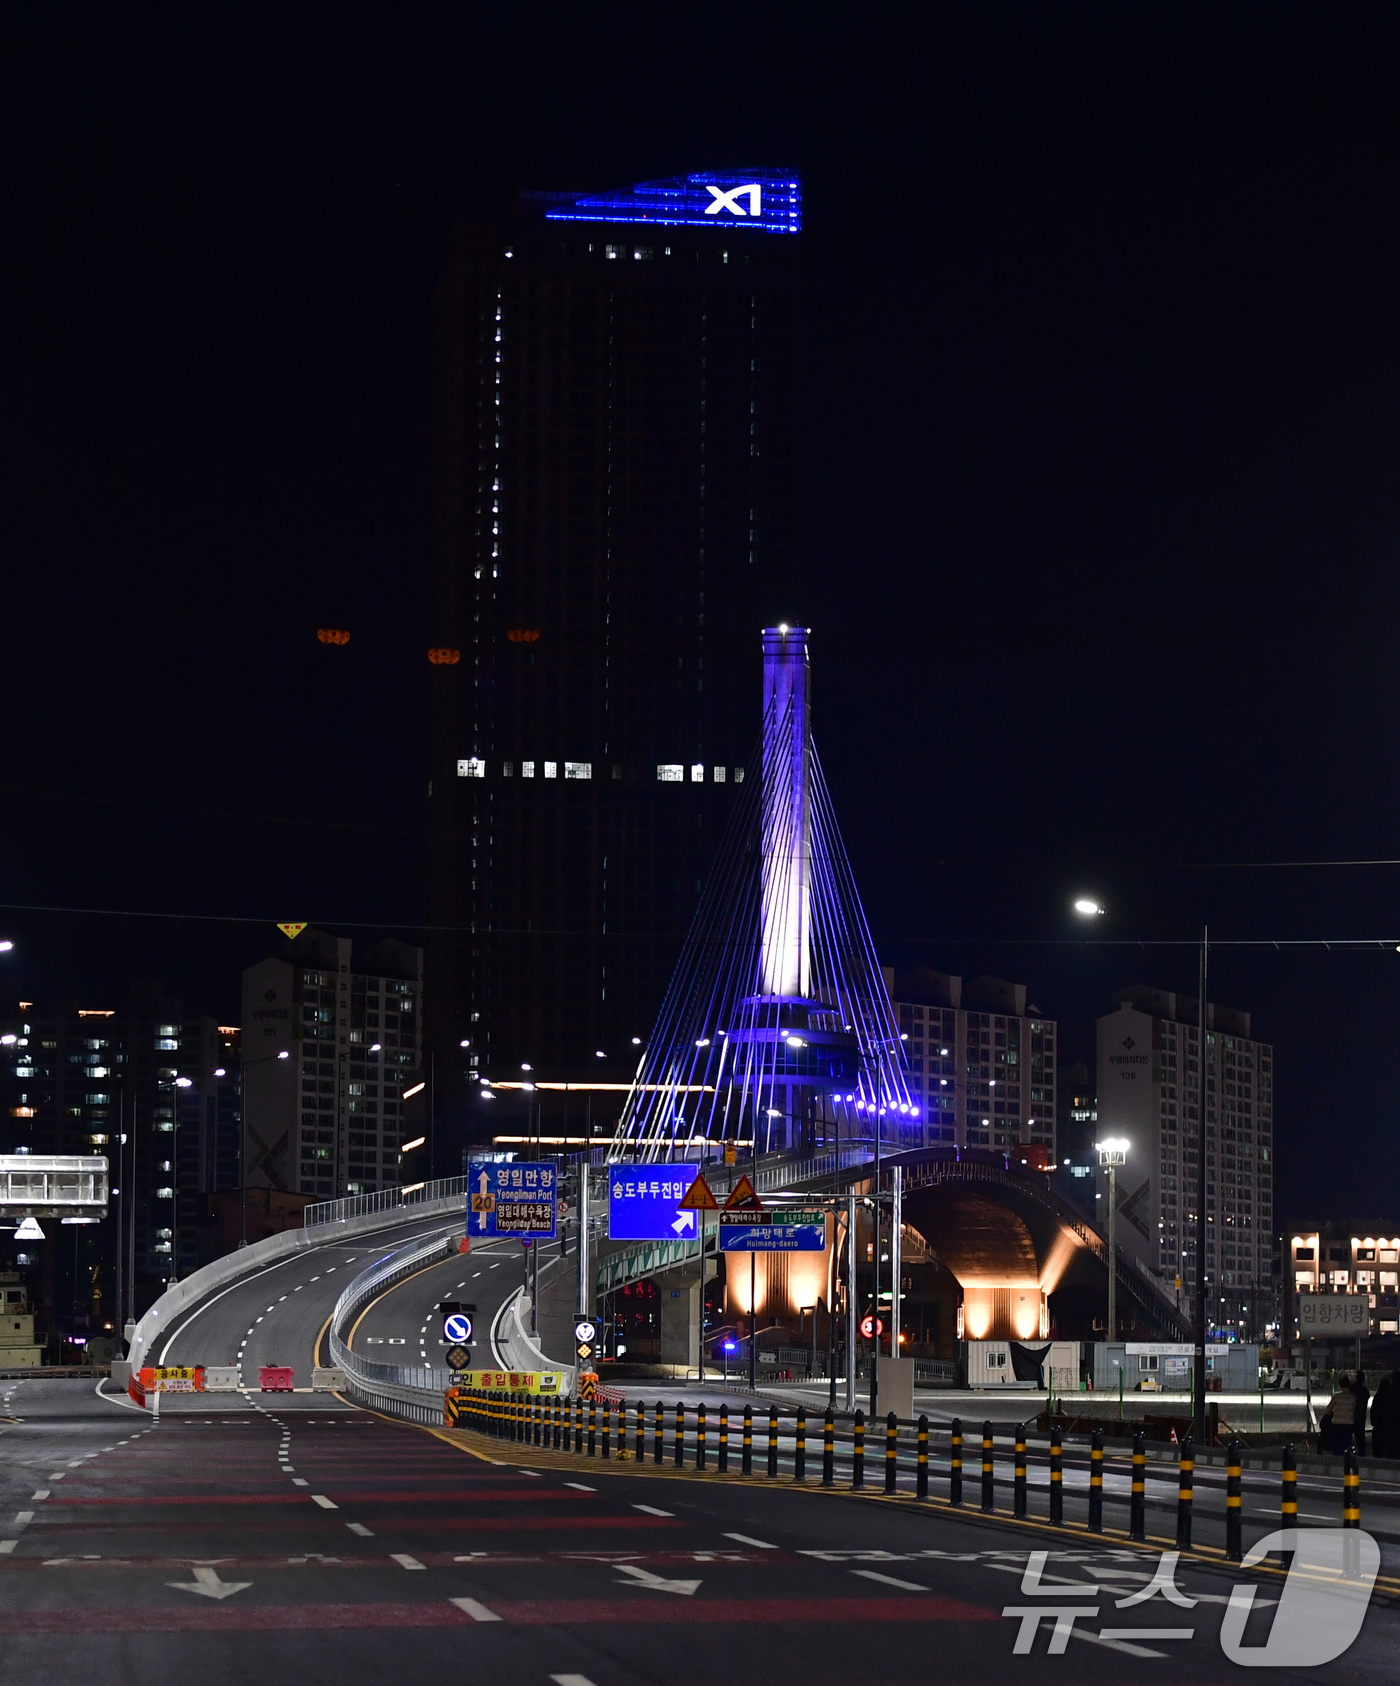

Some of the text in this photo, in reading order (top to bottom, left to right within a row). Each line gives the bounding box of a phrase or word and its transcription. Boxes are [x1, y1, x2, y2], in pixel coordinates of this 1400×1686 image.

[263, 1028, 276, 1037] 101
[497, 1169, 553, 1187] 영일만항
[497, 1189, 553, 1201] Yeongilman Port
[475, 1196, 492, 1210] 20
[497, 1204, 551, 1218] 영일대해수욕장
[783, 1213, 815, 1223] 송도부두진입로
[497, 1219, 551, 1230] Yeongildae Beach
[750, 1227, 795, 1239] 희망대로
[1302, 1304, 1365, 1324] 입항차량
[160, 1369, 188, 1379] 공사중
[480, 1373, 534, 1387] 출입통제
